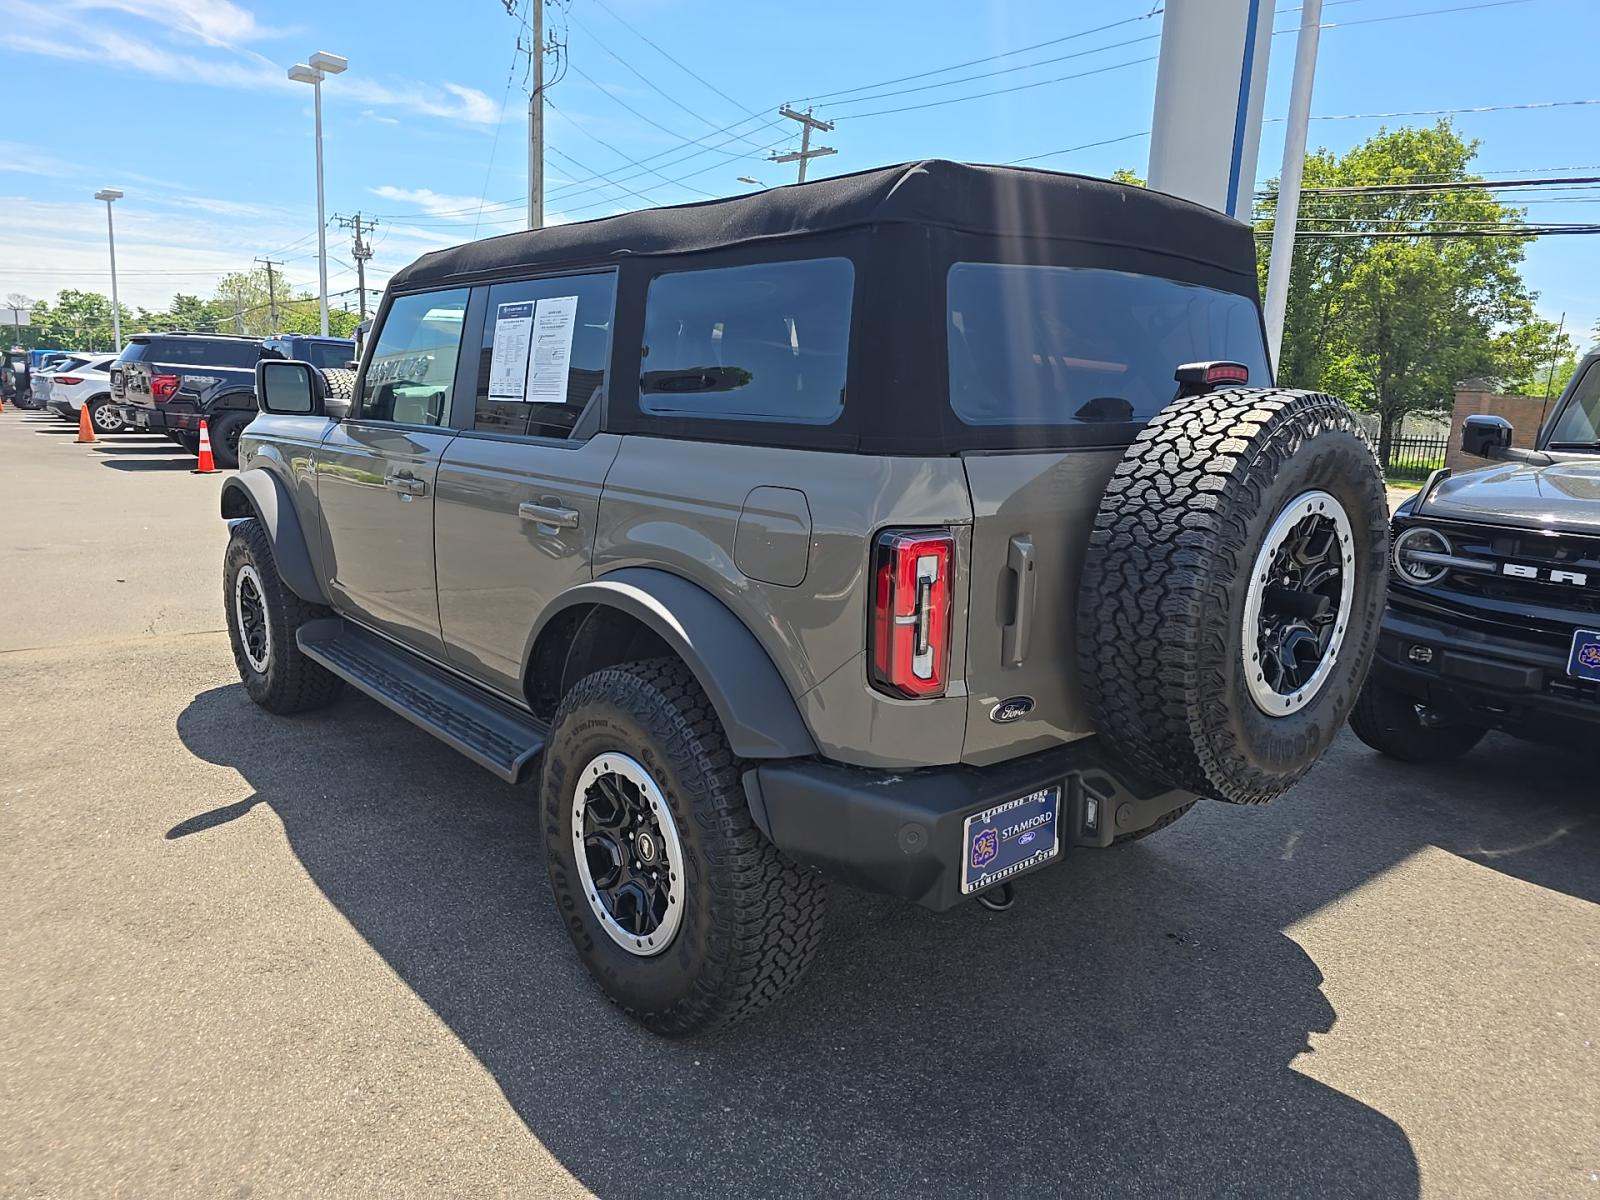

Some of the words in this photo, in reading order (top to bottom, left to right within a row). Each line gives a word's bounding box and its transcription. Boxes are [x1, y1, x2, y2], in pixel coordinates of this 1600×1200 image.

[1001, 704, 1027, 719] Ford
[1002, 811, 1053, 839] STAMFORD
[968, 849, 1055, 892] STAMFORDFORD.COM
